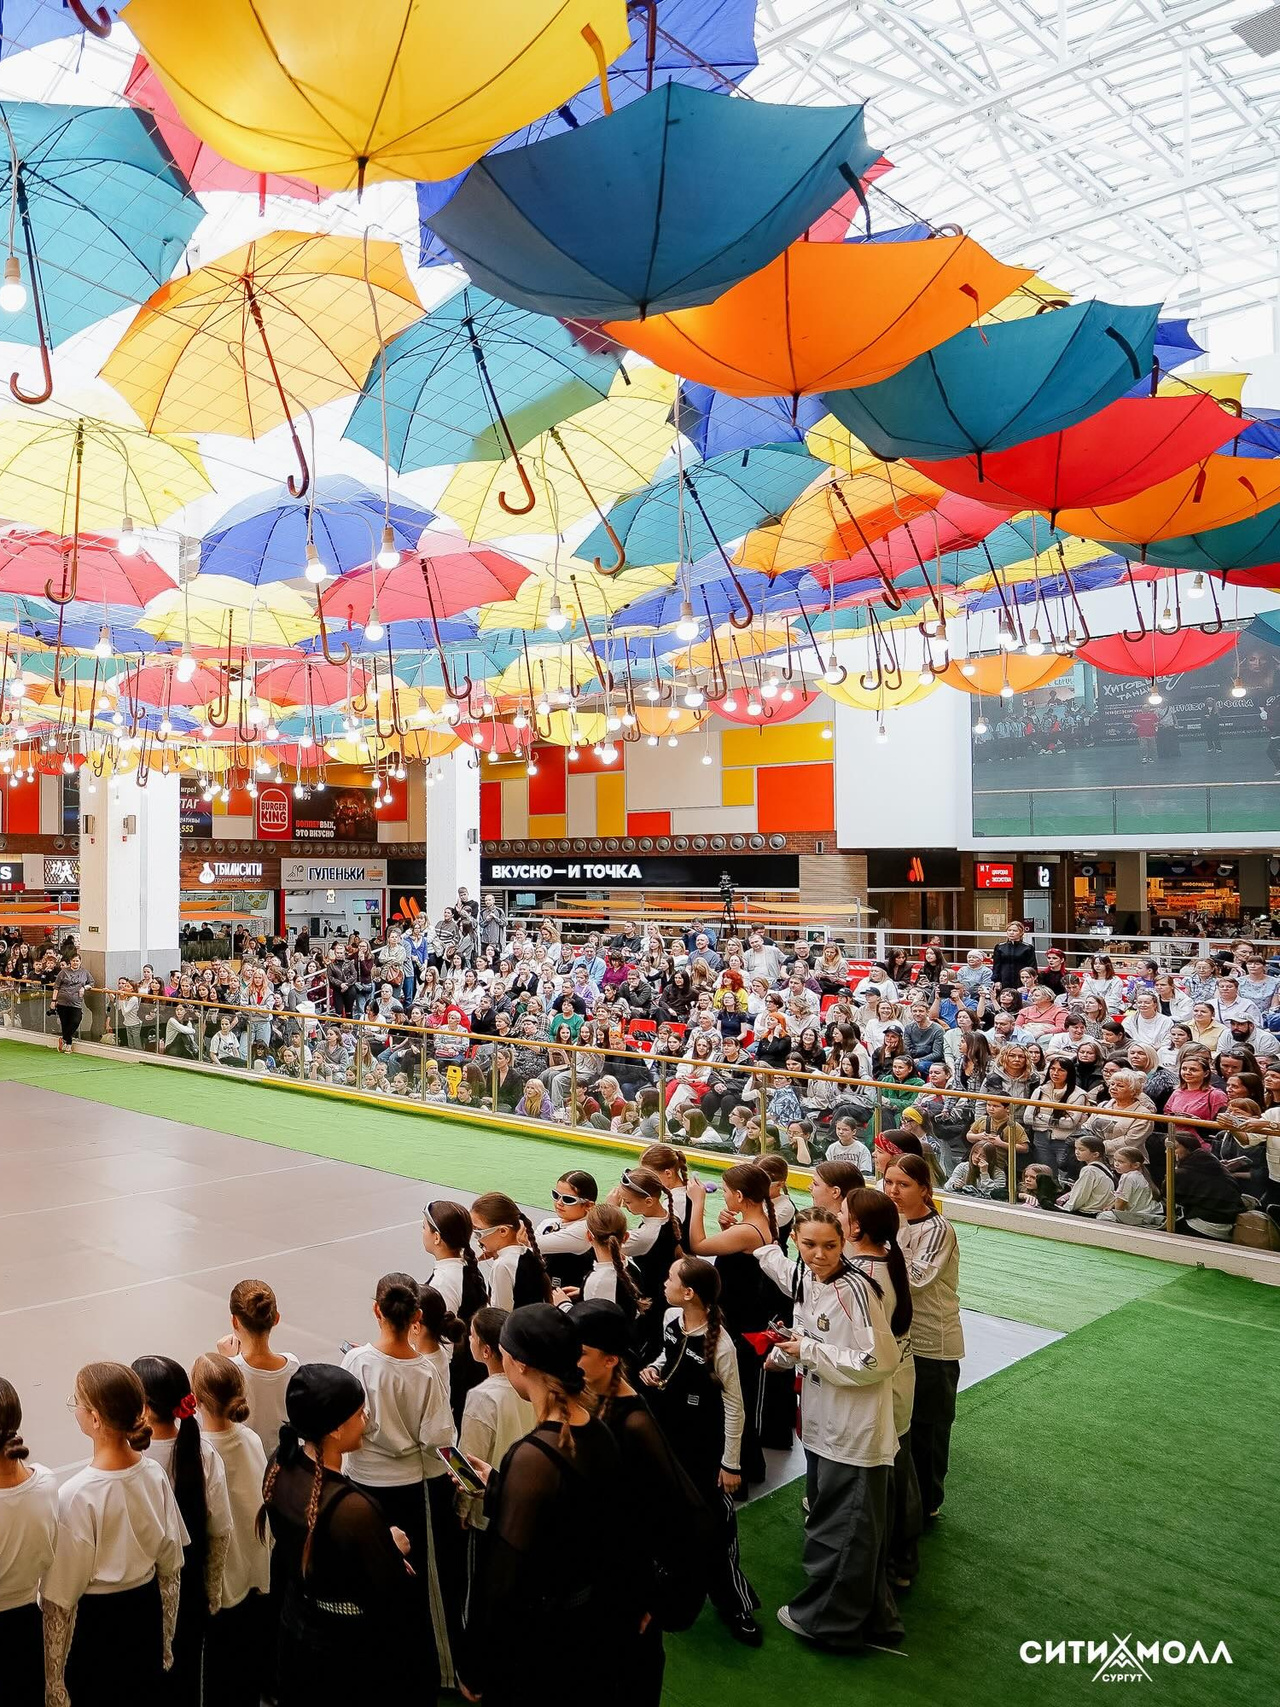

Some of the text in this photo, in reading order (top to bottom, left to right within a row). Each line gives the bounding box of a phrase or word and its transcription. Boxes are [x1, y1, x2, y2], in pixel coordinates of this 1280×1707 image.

[261, 802, 287, 811] BURGER
[261, 811, 287, 823] KING
[295, 829, 335, 838] ЭТО ВКУСНО
[213, 862, 263, 876] ТБИЛИСИТИ
[307, 866, 365, 881] ГУЛЕНЬКИ
[491, 864, 553, 879] ВКУСНО
[567, 864, 581, 878] И
[583, 864, 643, 879] ТОЧКА
[243, 875, 261, 884] бистро
